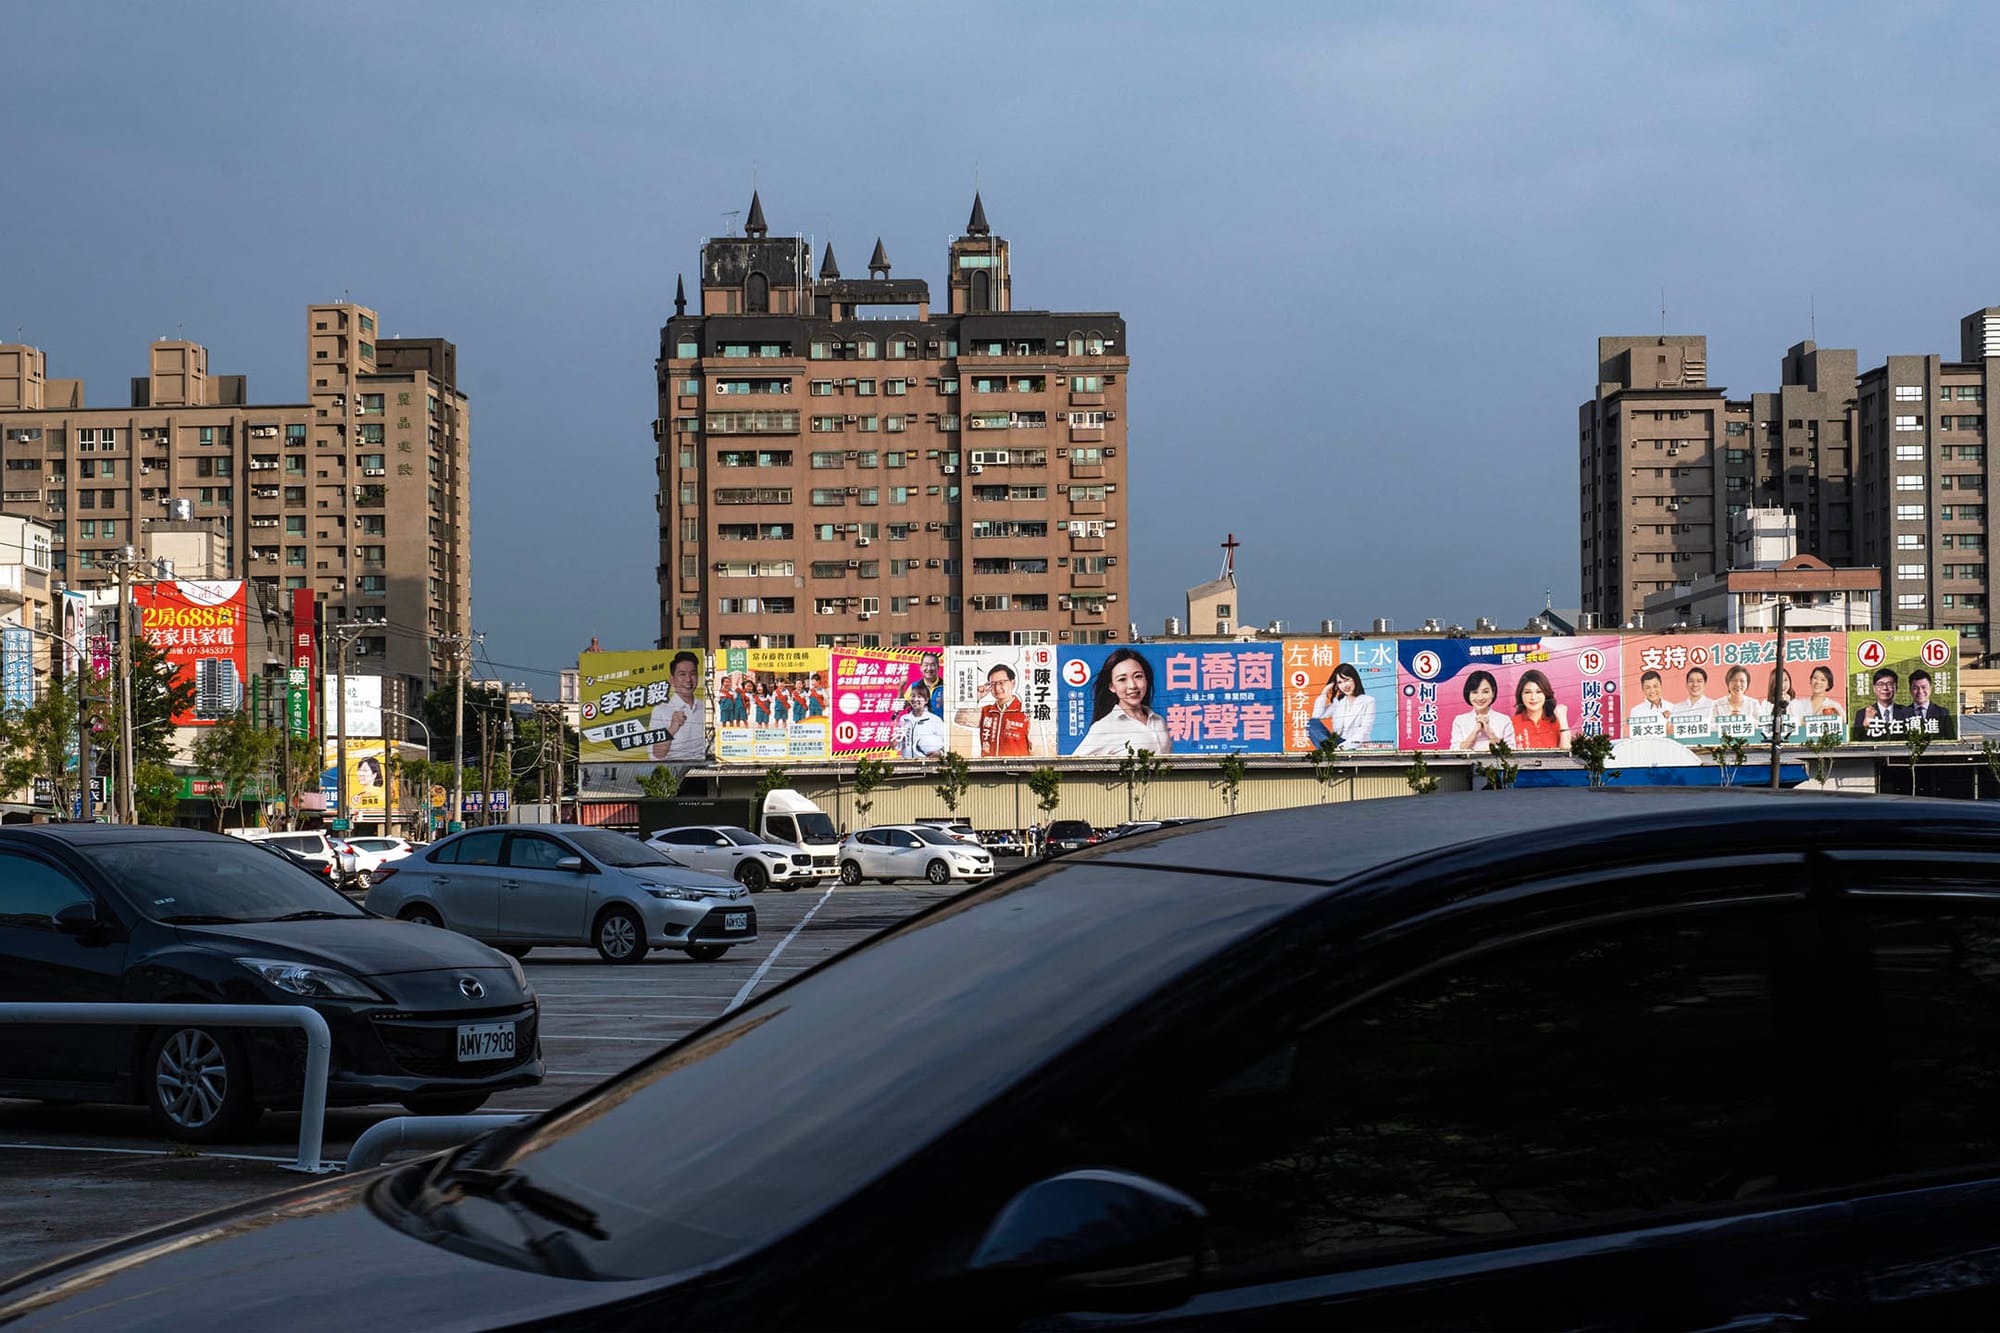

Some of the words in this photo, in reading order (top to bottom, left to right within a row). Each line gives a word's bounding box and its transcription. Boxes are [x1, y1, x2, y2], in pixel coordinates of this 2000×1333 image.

[143, 607, 234, 627] 2房688萬
[144, 628, 234, 646] 送家具家電
[187, 646, 234, 655] 07-3453377
[752, 652, 809, 661] 常春藤教育機構
[1036, 651, 1048, 663] 18
[1287, 643, 1334, 667] 左楠
[1347, 643, 1393, 666] 上水
[1640, 645, 1688, 672] 支持
[1711, 637, 1830, 665] 18歲公民權
[1863, 643, 1880, 663] 4
[1926, 644, 1944, 661] 16
[1420, 655, 1432, 674] 3
[1584, 653, 1599, 670] 19
[289, 669, 306, 686] 藥
[1069, 661, 1087, 685] 3
[1166, 652, 1274, 690] 白喬茵
[1295, 673, 1306, 687] 9
[600, 681, 669, 715] 李柏毅
[1033, 668, 1051, 721] 陳子瑜
[1184, 692, 1215, 702] 主播上陣
[1224, 692, 1255, 701] 專業問政
[583, 703, 594, 718] 2
[860, 697, 905, 713] 王振華
[1418, 682, 1438, 743] 柯志恩
[1582, 680, 1602, 738] 陳玫娟
[1167, 703, 1275, 741] 新聲音
[1291, 689, 1311, 748] 李雅慧
[1866, 716, 1940, 738] 志在邁進
[592, 722, 638, 738] 一直都在
[839, 726, 854, 739] 10
[858, 726, 907, 743] 李雅芬
[1632, 724, 1665, 736] 黃文志
[1676, 723, 1709, 735] 李柏毅
[1720, 723, 1753, 734] 劉世芳
[621, 730, 667, 749] 做事努力
[459, 1031, 514, 1056] AMV-7908
